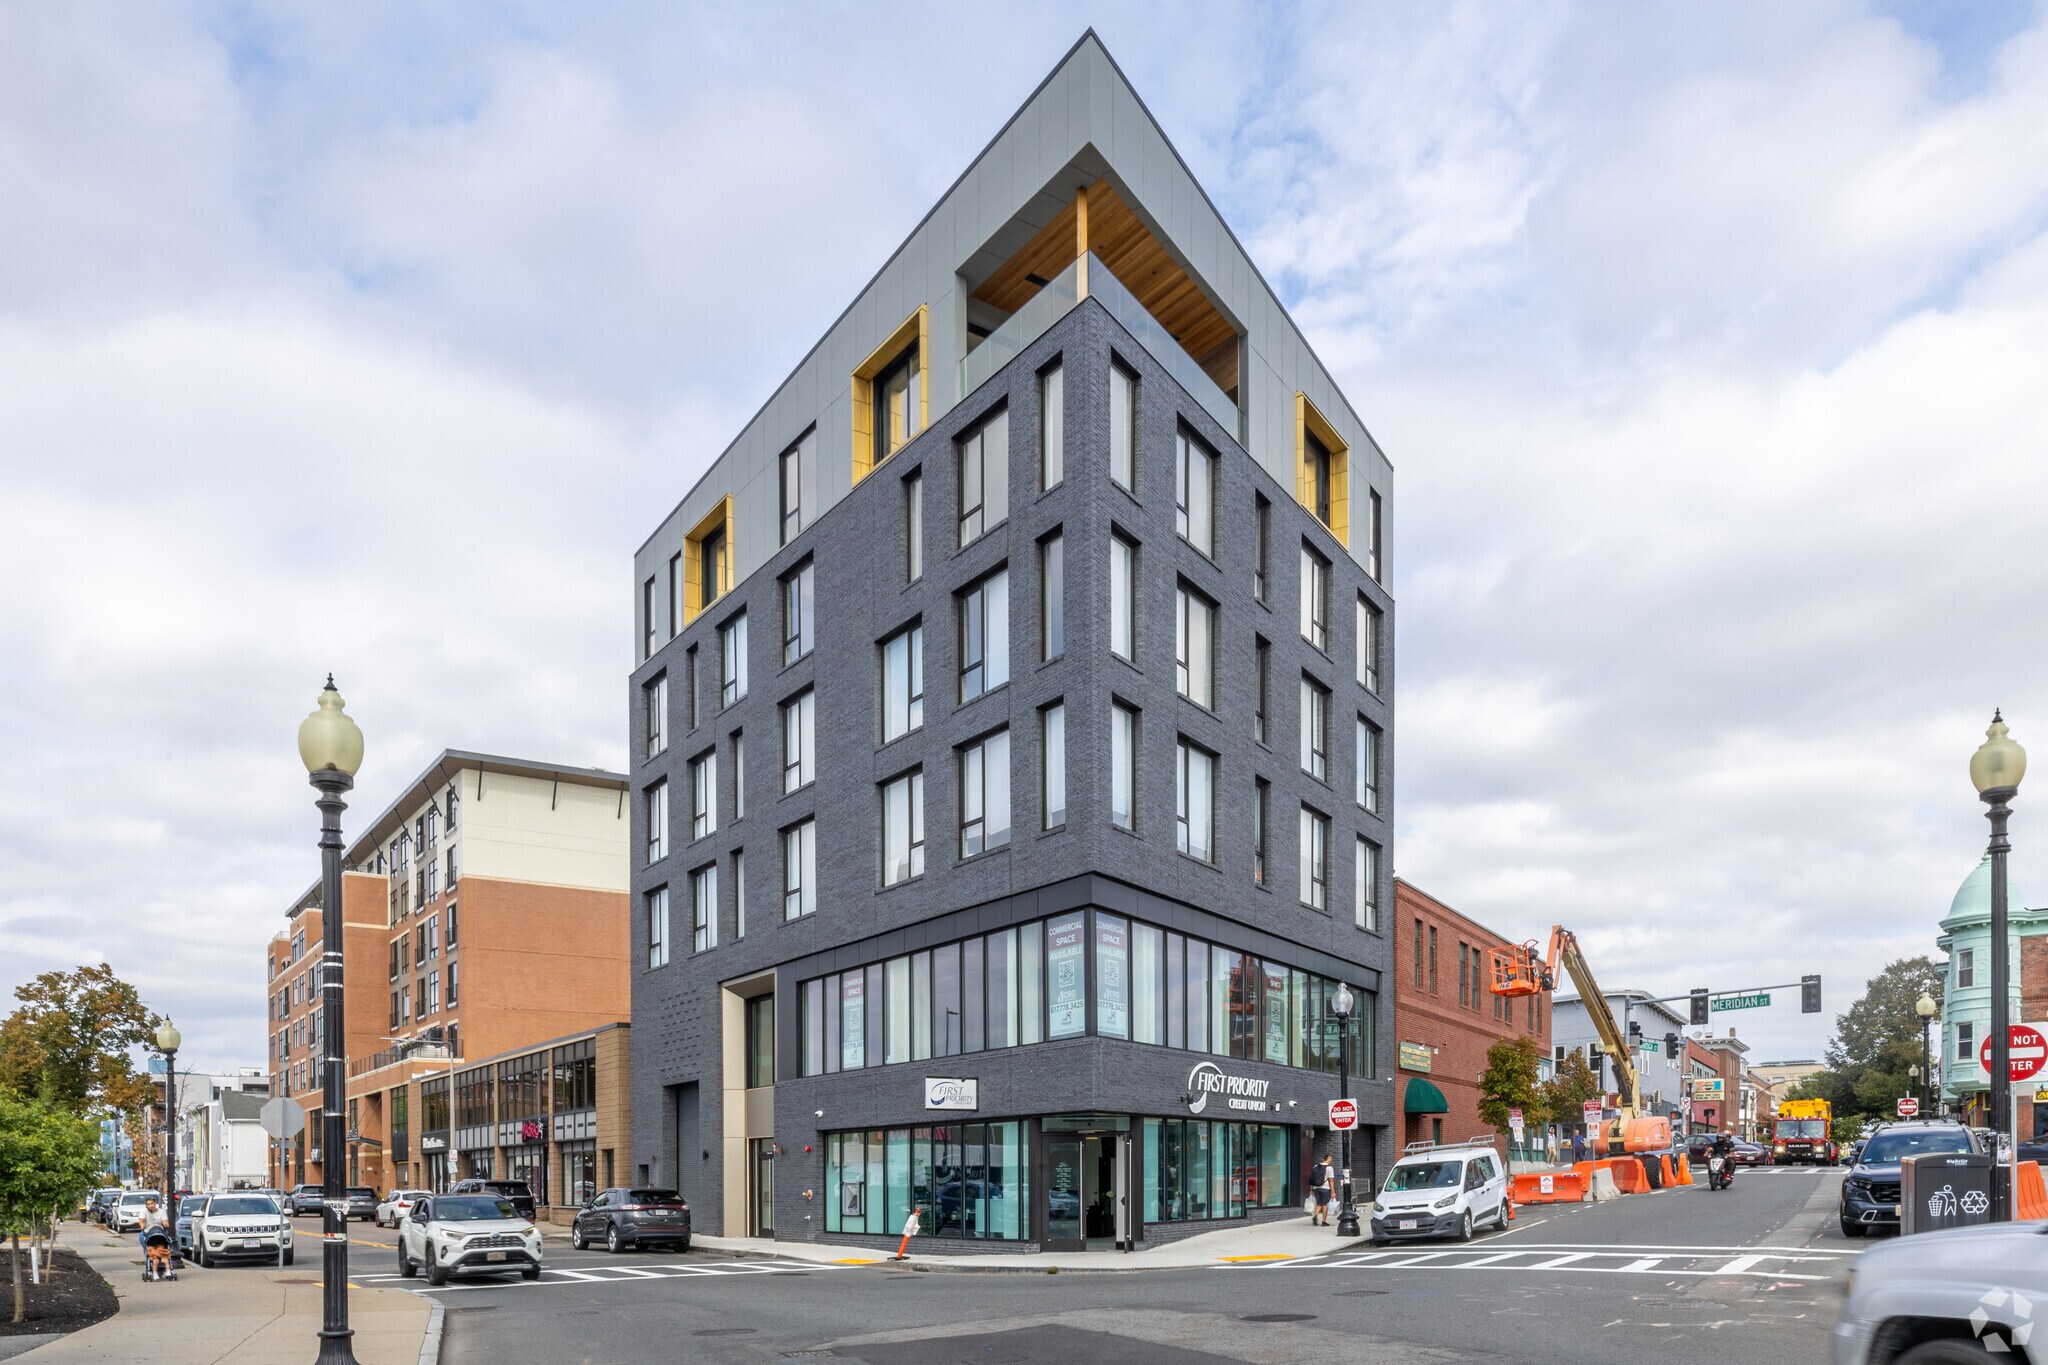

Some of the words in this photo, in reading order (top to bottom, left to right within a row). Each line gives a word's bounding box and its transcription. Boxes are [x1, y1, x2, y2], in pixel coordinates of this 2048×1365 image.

[1049, 921, 1082, 936] COMMERCIAL
[1056, 934, 1076, 946] SPACE
[1103, 933, 1120, 945] SPACE
[1050, 946, 1083, 960] AVAILABLE
[848, 987, 861, 996] SPACE
[1064, 990, 1076, 1000] CRG
[1051, 1001, 1084, 1014] 617.778.3425
[1712, 996, 1758, 1011] MERIDIAN
[1760, 998, 1768, 1006] ST
[2013, 1035, 2038, 1046] NOT
[2010, 1061, 2033, 1071] TER
[939, 1086, 964, 1096] FIRST
[1197, 1072, 1227, 1093] FIRST
[1226, 1076, 1269, 1098] PRIORITY
[1228, 1098, 1247, 1110] CREDIT
[1247, 1099, 1266, 1112] UNION
